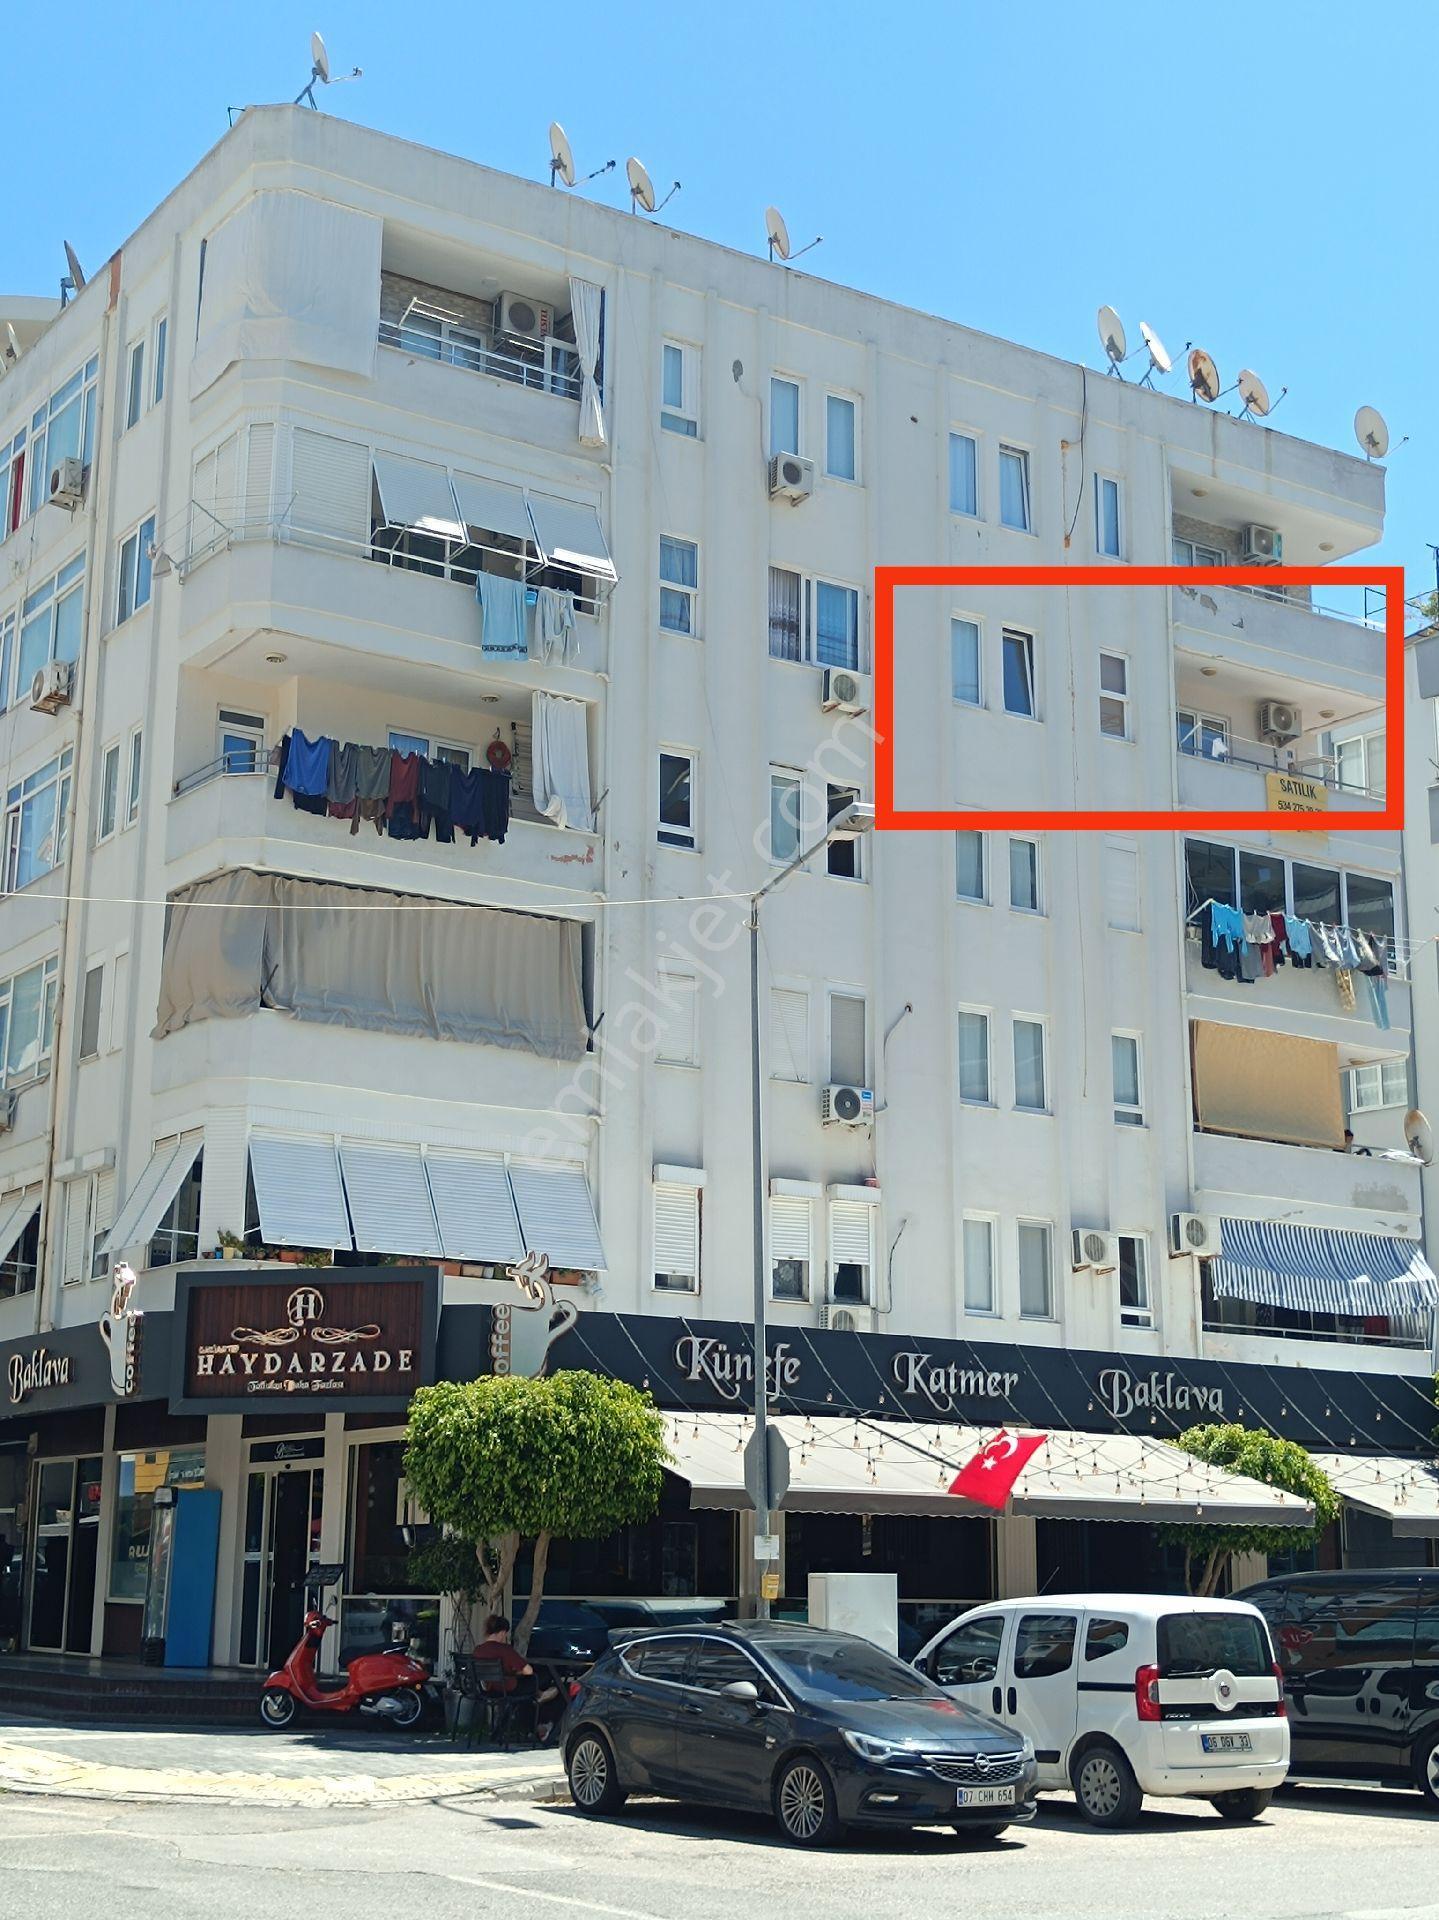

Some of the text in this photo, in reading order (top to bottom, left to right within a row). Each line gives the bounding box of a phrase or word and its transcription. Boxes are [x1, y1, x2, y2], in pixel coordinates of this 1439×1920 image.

[1278, 800, 1291, 811] 534
[1280, 779, 1317, 800] SATILIK
[490, 1304, 510, 1375] offee
[8, 1347, 69, 1403] Baklava
[197, 1350, 413, 1375] HAYDARZADE
[893, 1352, 1019, 1412] Katmer
[1099, 1369, 1224, 1418] Baklava
[963, 1790, 974, 1803] 07
[998, 1789, 1012, 1801] 654
